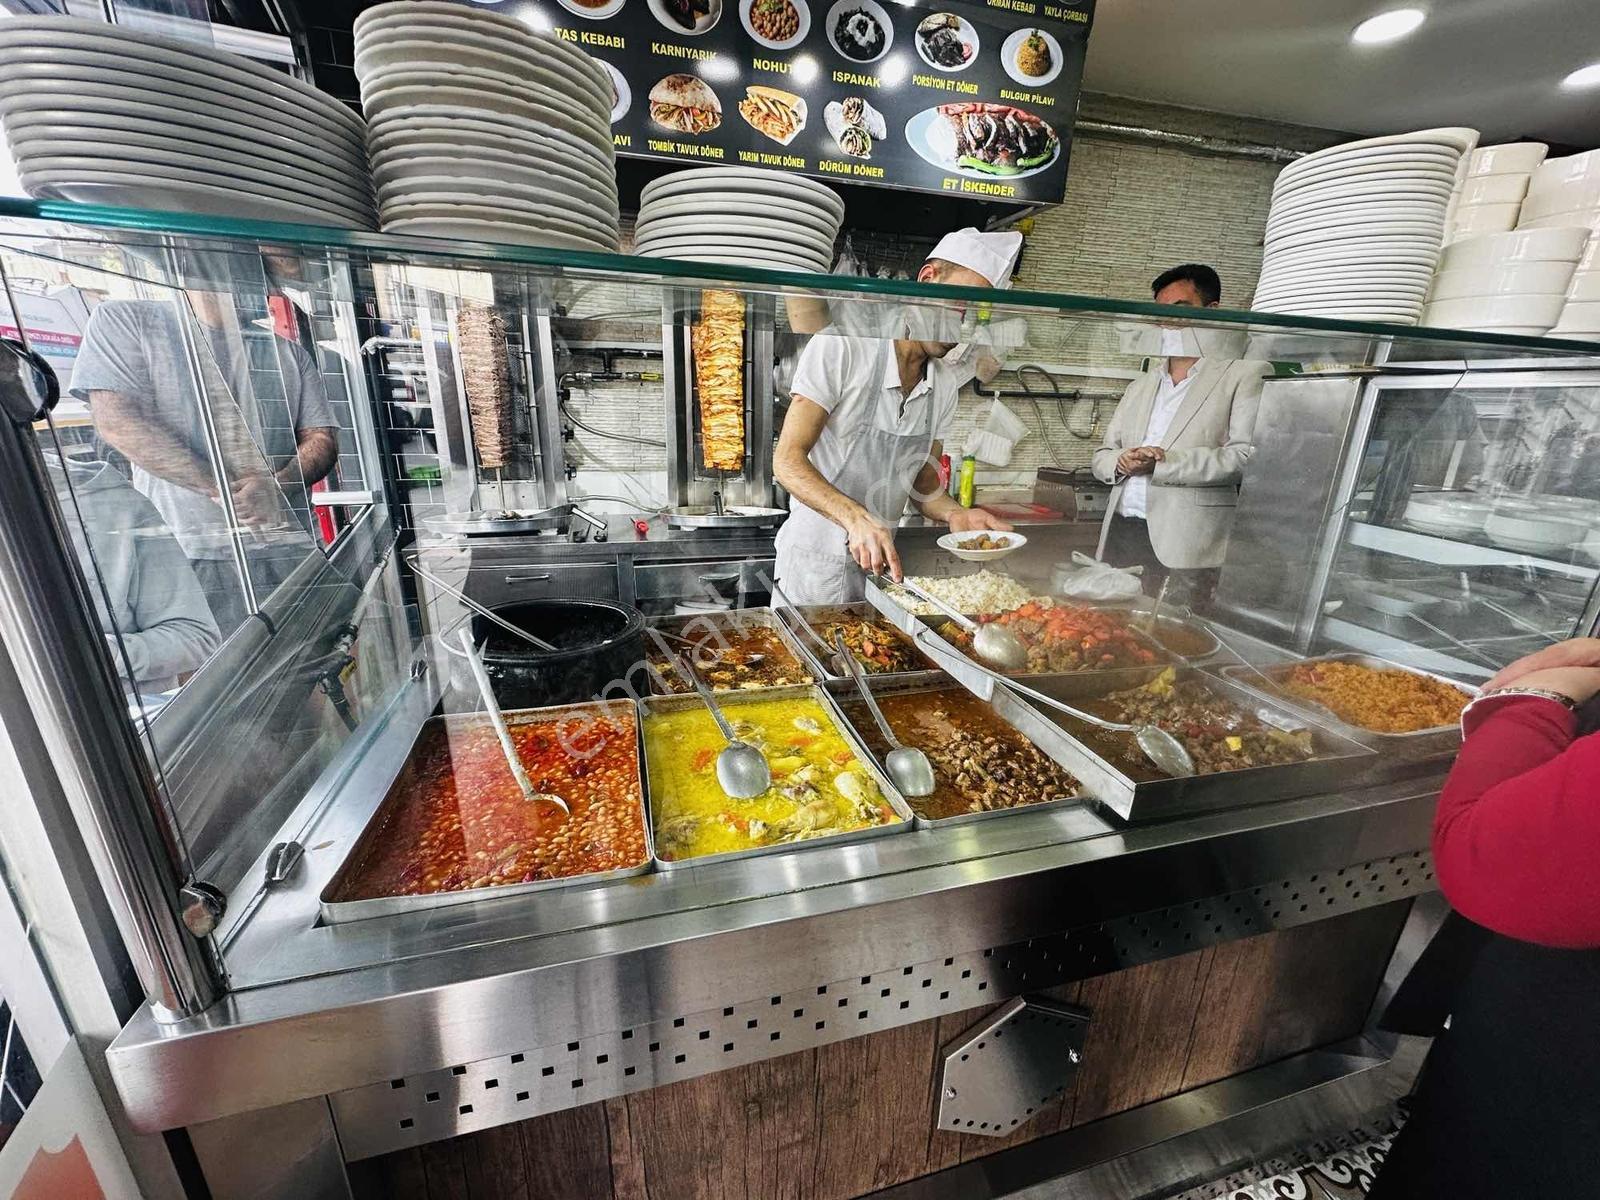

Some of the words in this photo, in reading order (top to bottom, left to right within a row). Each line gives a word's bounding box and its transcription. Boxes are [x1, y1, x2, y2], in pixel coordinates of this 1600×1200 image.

[987, 0, 1010, 9] ORMAN
[1011, 1, 1035, 14] KEBABI
[1044, 5, 1062, 18] YAYLA
[555, 28, 577, 41] TAS
[581, 32, 625, 48] KEBABI
[652, 43, 717, 61] KARNIYARIK
[833, 71, 880, 88] ISPANAK
[912, 75, 945, 89] PORSİYON
[946, 80, 955, 91] ET
[956, 81, 978, 95] DÖNER
[1000, 89, 1030, 101] BULGUR
[1031, 94, 1055, 106] PİLAVI
[613, 134, 631, 146] AVI
[648, 139, 674, 153] TOMBİK
[676, 143, 699, 155] TAVUK
[701, 146, 724, 159] DÖNER
[738, 151, 759, 163] YARIM
[760, 153, 781, 165] TAVUK
[783, 155, 806, 168] DÖNER
[819, 161, 852, 174] DÜRÜM
[853, 165, 884, 178] DÖNER
[943, 178, 958, 190] ET
